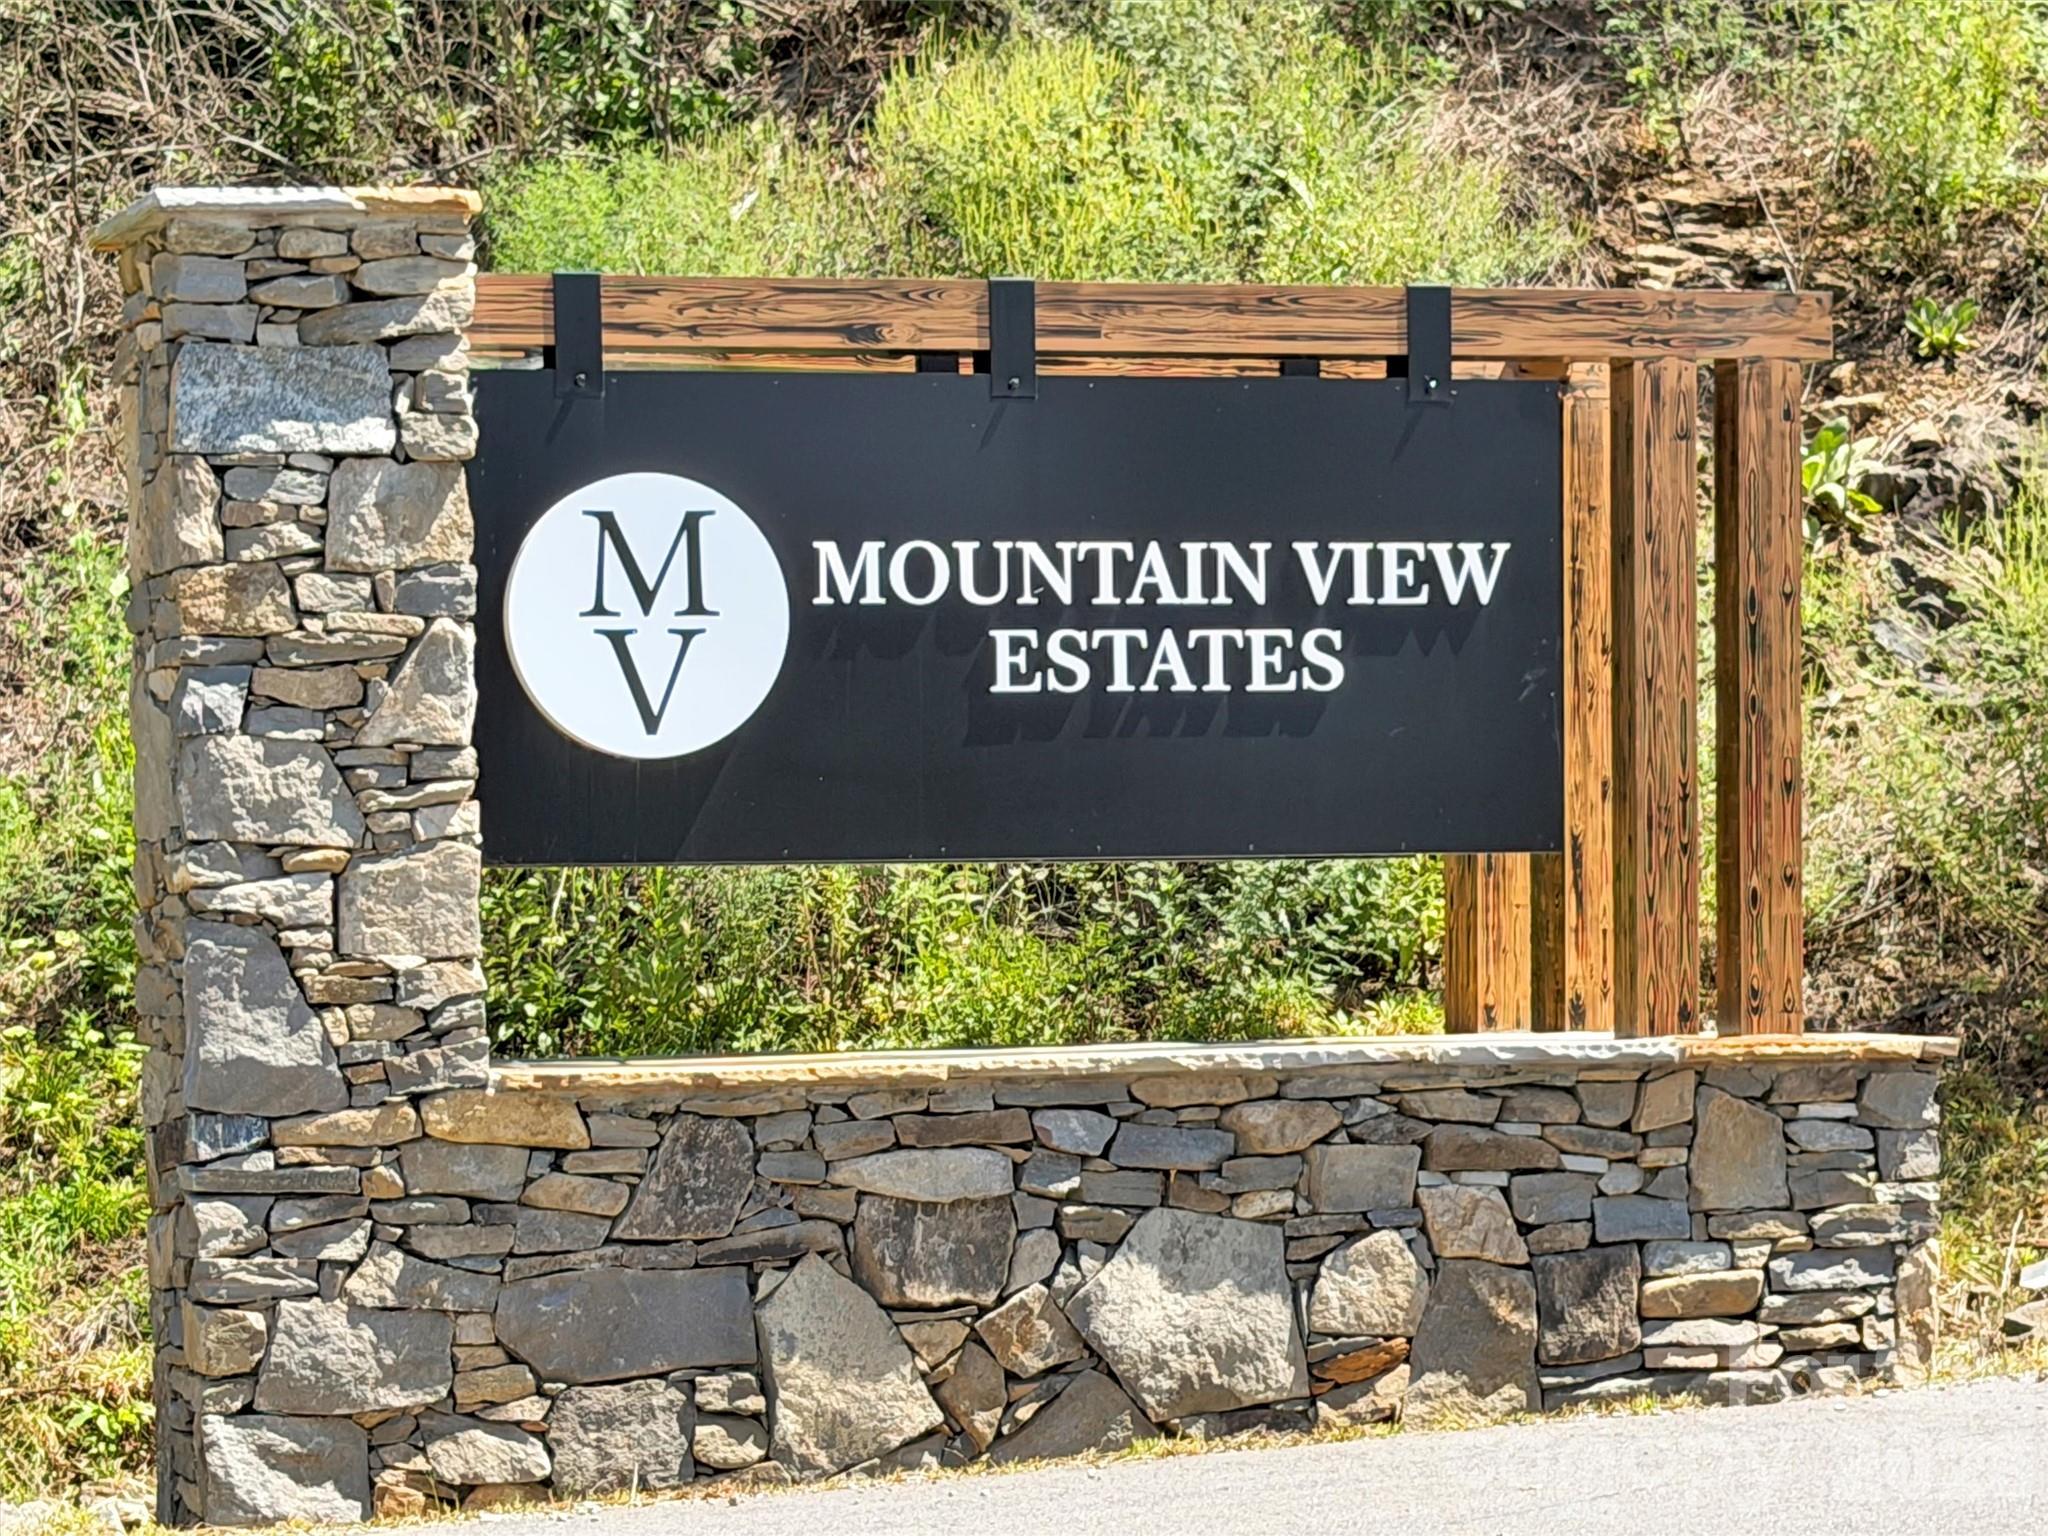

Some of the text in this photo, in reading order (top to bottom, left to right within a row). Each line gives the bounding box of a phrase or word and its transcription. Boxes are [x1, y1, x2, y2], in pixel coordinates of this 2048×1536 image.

[580, 511, 718, 615] M
[812, 540, 1511, 606] MOUNTAIN VIEW
[594, 629, 706, 735] V
[989, 628, 1344, 693] ESTATES
